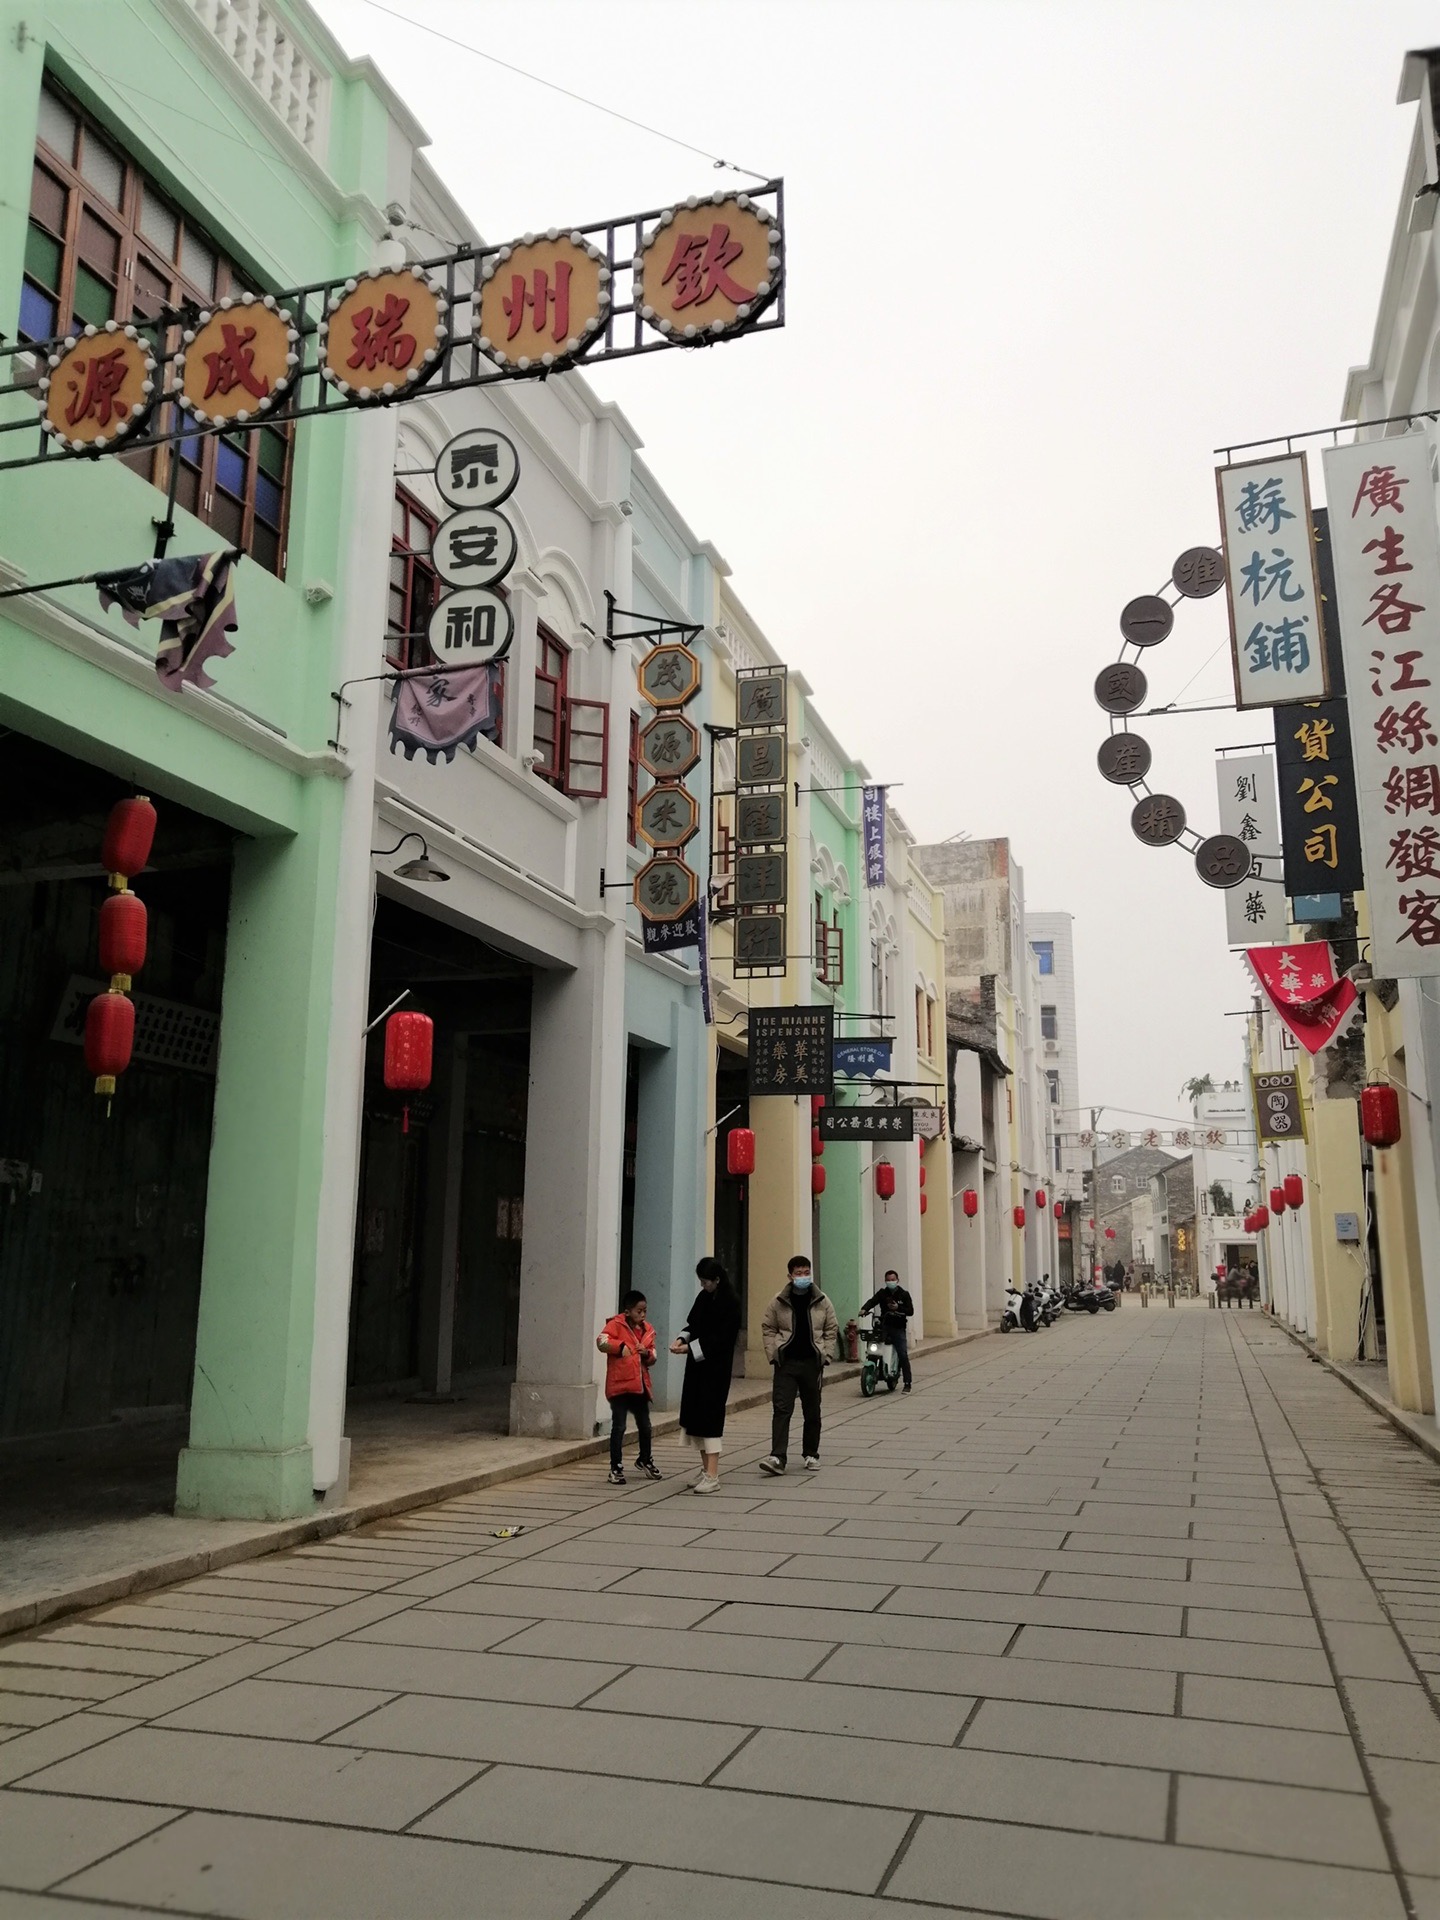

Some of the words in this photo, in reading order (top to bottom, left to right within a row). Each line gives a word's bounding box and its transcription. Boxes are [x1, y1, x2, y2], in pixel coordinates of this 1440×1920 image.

[445, 443, 499, 649] 泰安和
[1233, 476, 1311, 676] 蘇杭鋪
[755, 1017, 777, 1026] THE
